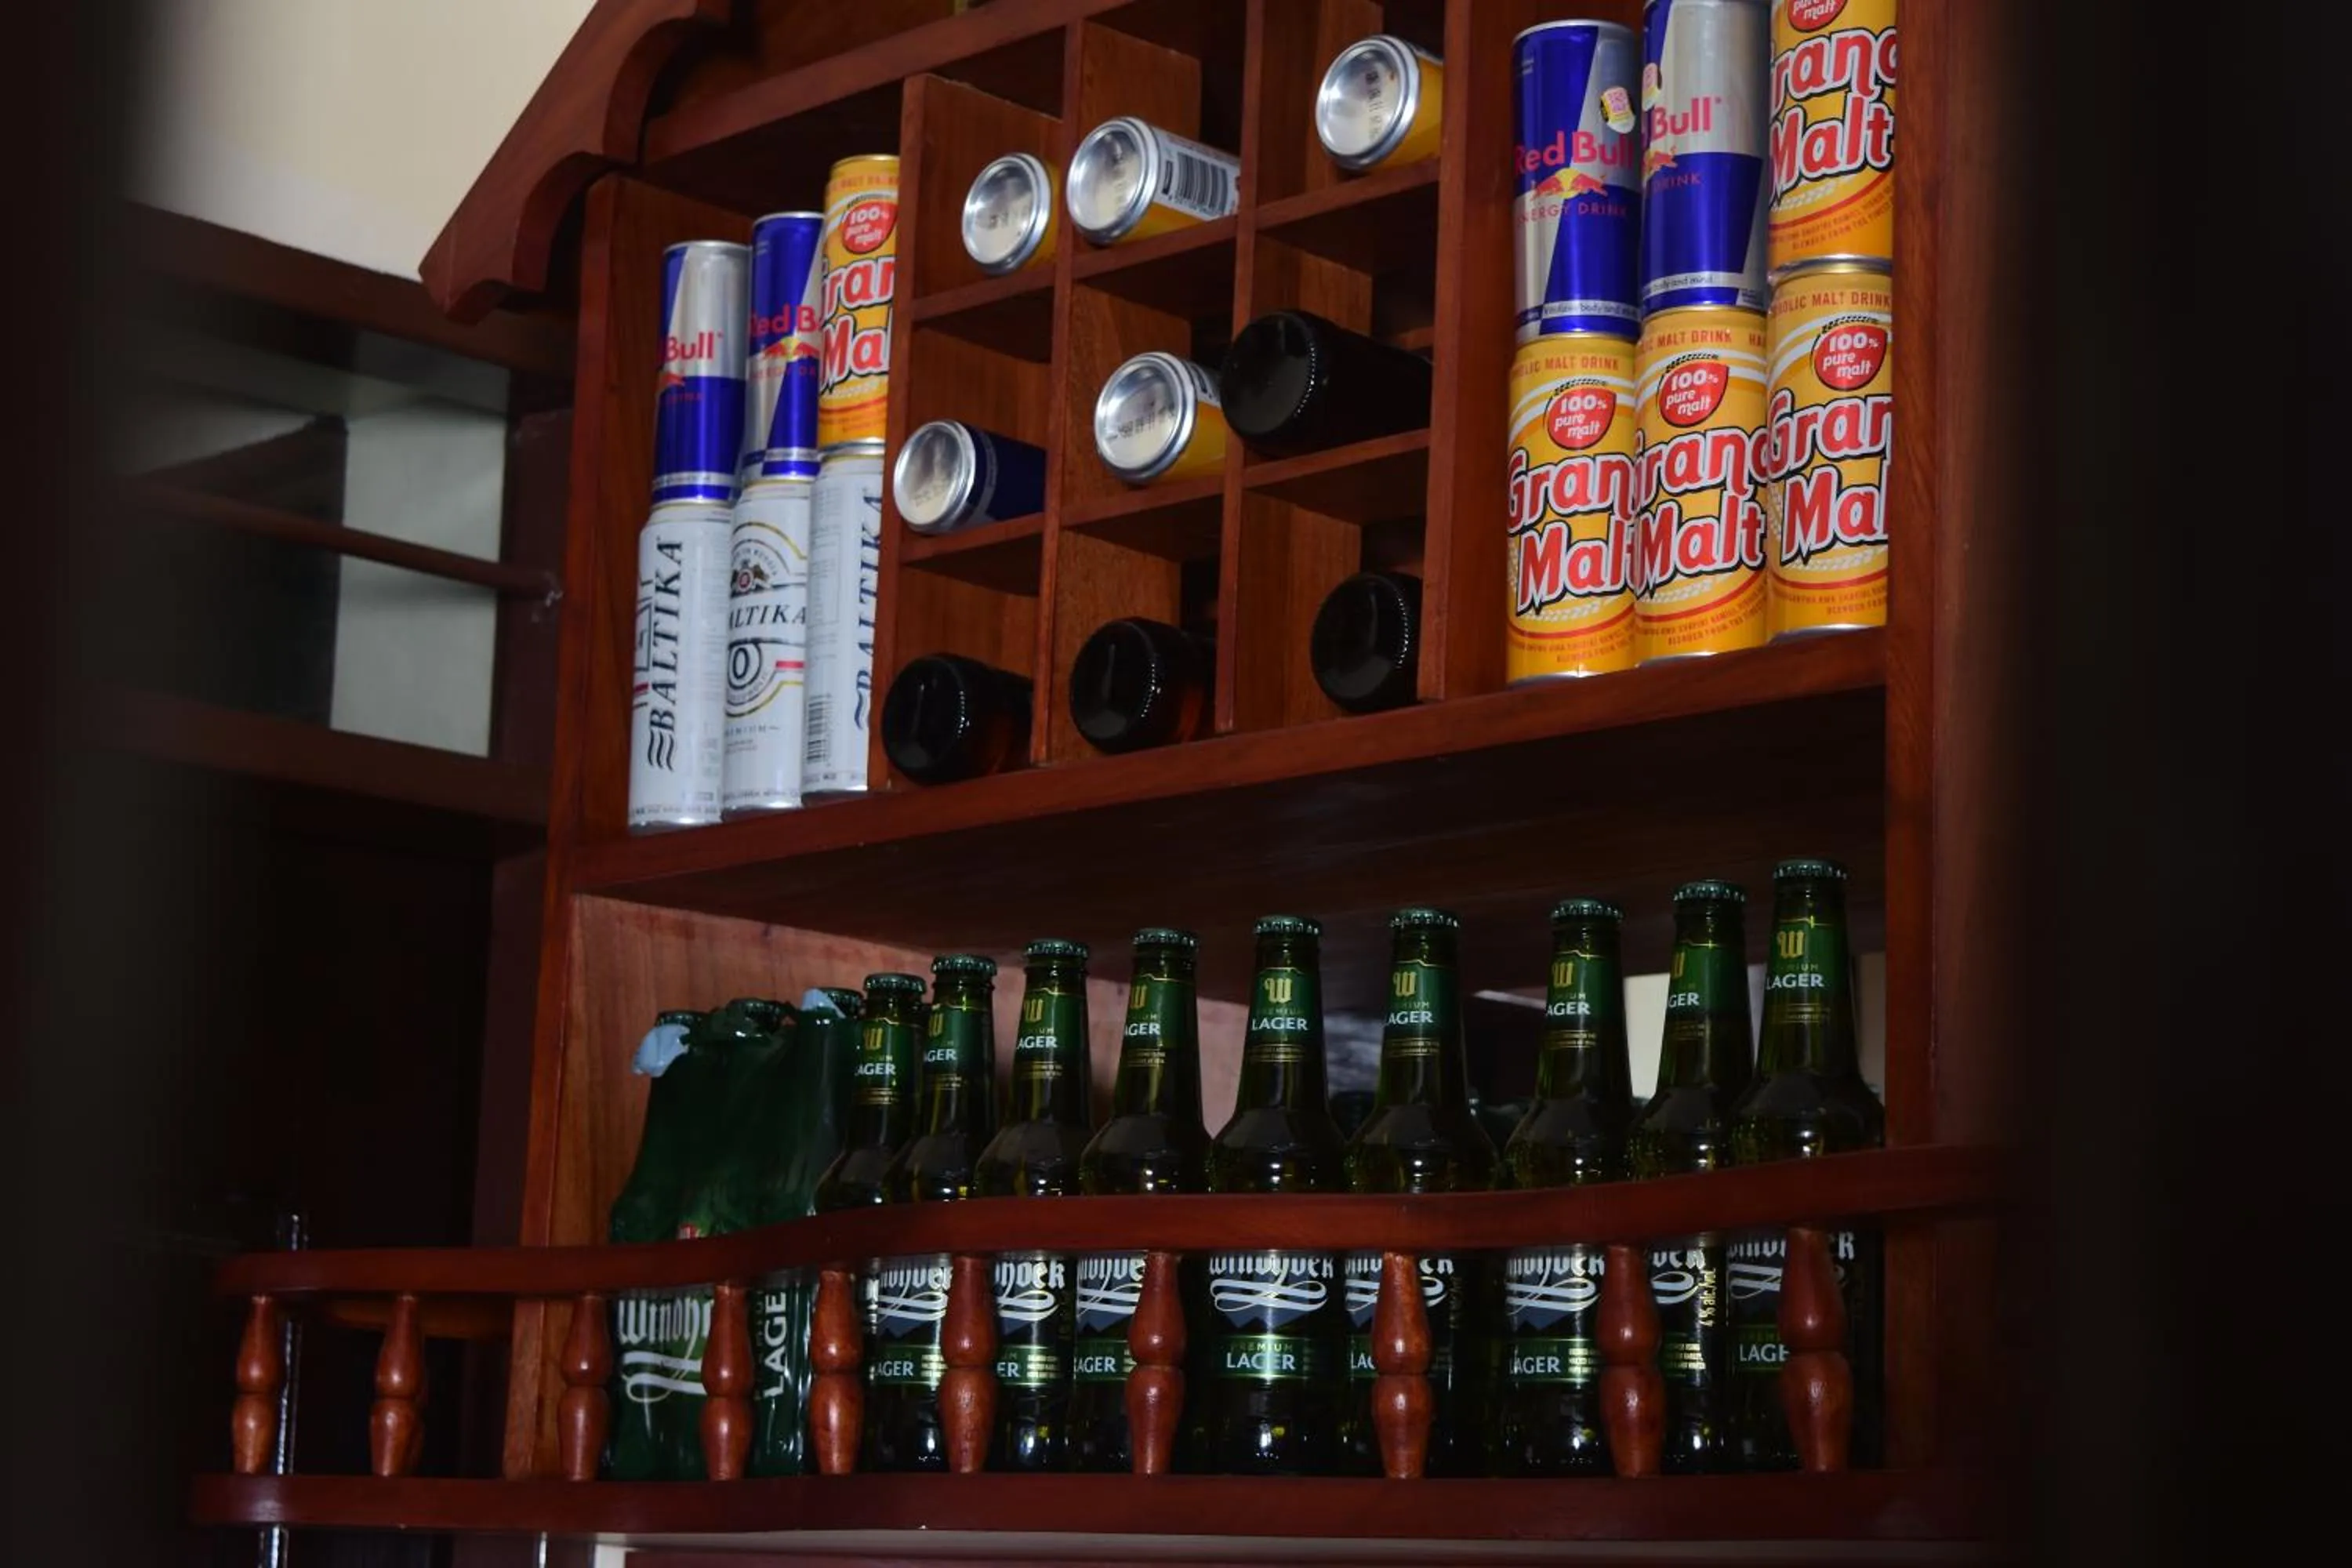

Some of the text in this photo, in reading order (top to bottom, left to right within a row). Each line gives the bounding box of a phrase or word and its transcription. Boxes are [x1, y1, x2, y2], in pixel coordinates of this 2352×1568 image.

[1651, 96, 1711, 141] Bull
[1514, 129, 1635, 174] Red Bull
[1770, 93, 1893, 198] Malt
[1517, 203, 1571, 224] NERGY
[1812, 292, 1844, 308] MALT
[1851, 292, 1891, 308] DRINK
[665, 331, 715, 362] Bull
[1657, 331, 1686, 347] MALT
[1691, 329, 1732, 343] DRINK
[1828, 332, 1879, 353] 100%
[1823, 351, 1857, 372] pure
[1836, 359, 1872, 380] malt
[1671, 368, 1719, 391] 100%
[1559, 394, 1608, 413] 100%
[1665, 390, 1696, 410] pure
[1677, 394, 1711, 417] malt
[1507, 448, 1637, 534] Gran
[1637, 490, 1766, 595] Malt
[648, 540, 683, 734] BALTIKA
[1766, 972, 1826, 991] LAGER
[1388, 1010, 1434, 1025] AGER
[1546, 1000, 1592, 1017] AGER
[1251, 1017, 1308, 1031] LAGER
[1016, 1035, 1058, 1051] AGER
[763, 1290, 787, 1400] LAGE
[1739, 1342, 1791, 1363] LAGE
[1226, 1352, 1296, 1370] LAGER
